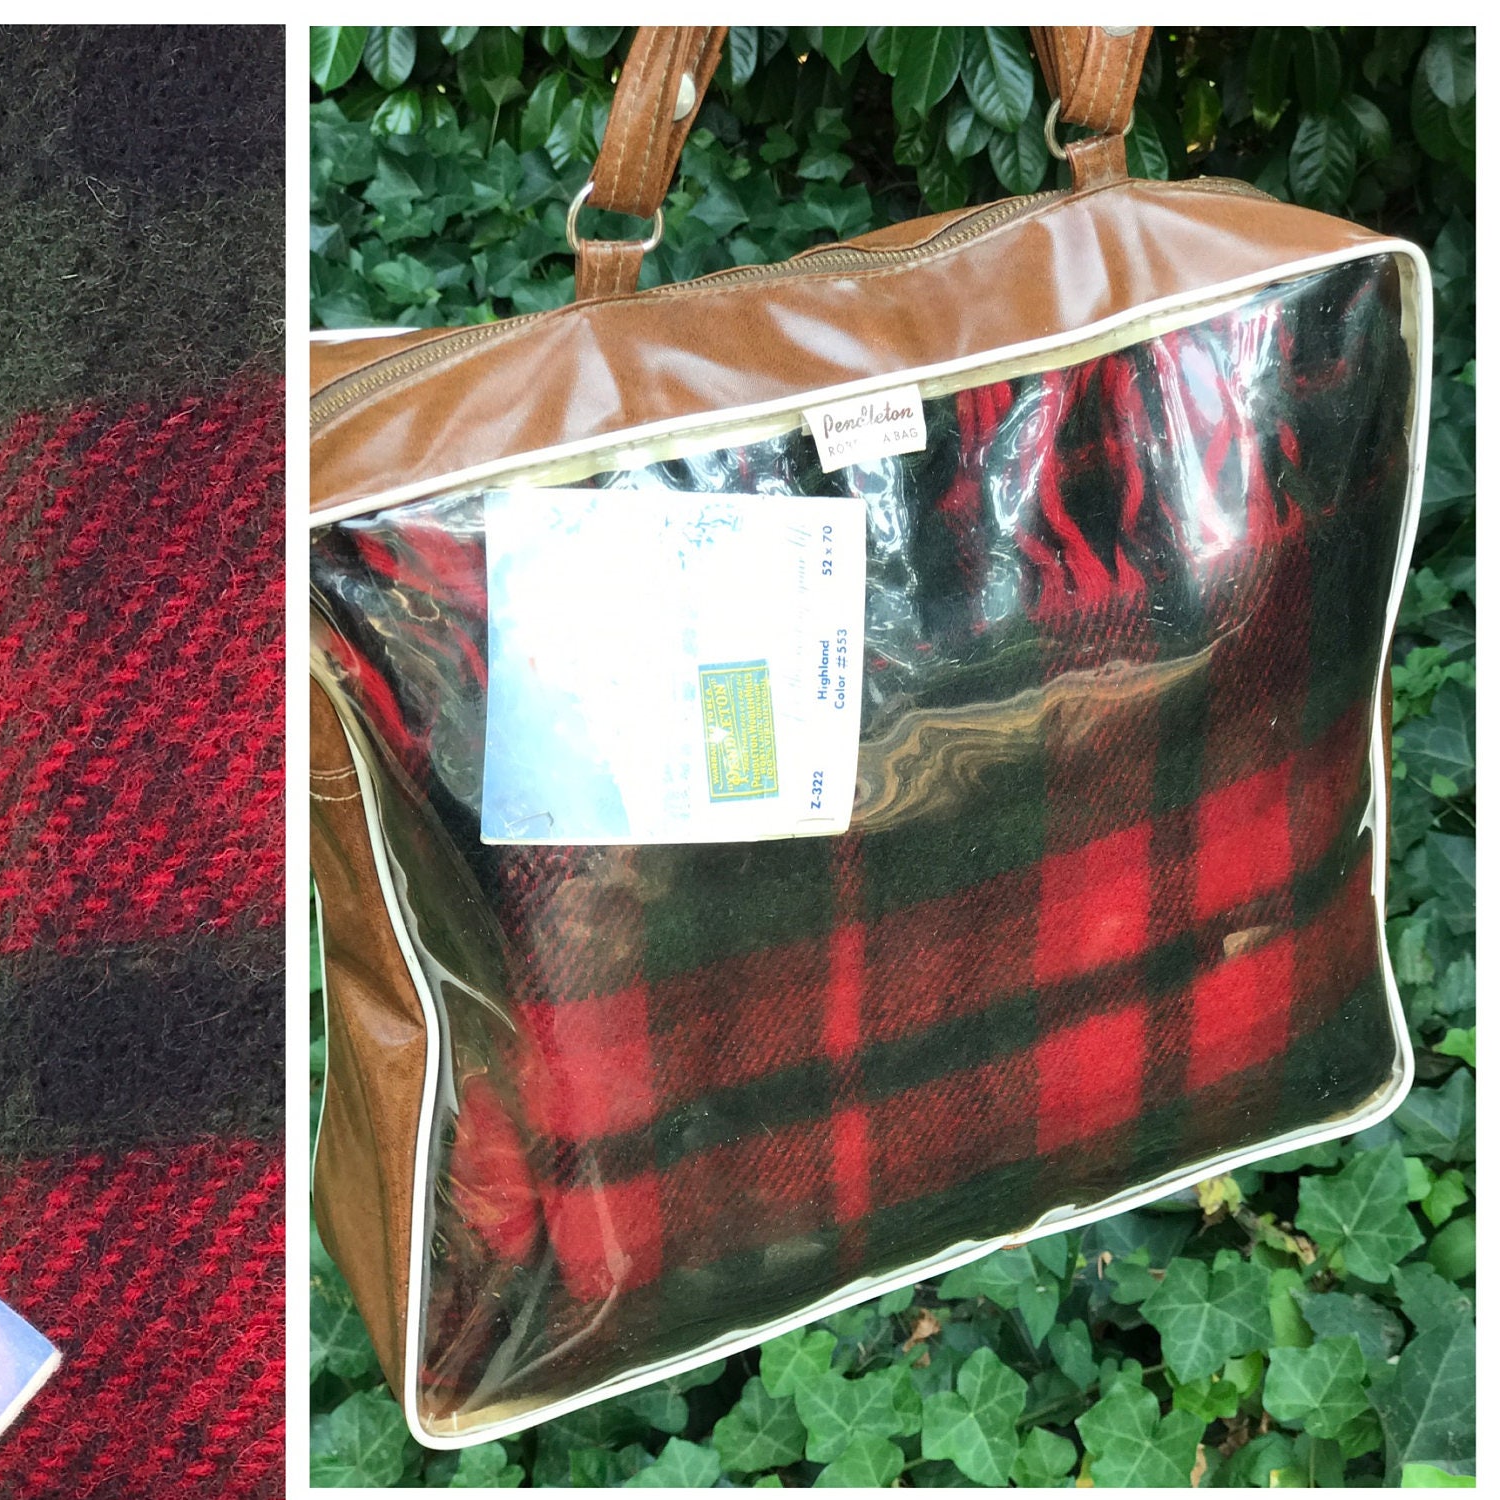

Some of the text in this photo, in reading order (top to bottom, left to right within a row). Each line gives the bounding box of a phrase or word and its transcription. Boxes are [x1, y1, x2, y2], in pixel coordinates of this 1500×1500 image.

[824, 401, 914, 439] Pendleton
[894, 428, 918, 441] BAG
[822, 525, 833, 542] 70
[822, 560, 832, 576] 52
[817, 640, 831, 699] Highland
[834, 629, 848, 709] Color #553
[811, 771, 823, 809] Z-322
